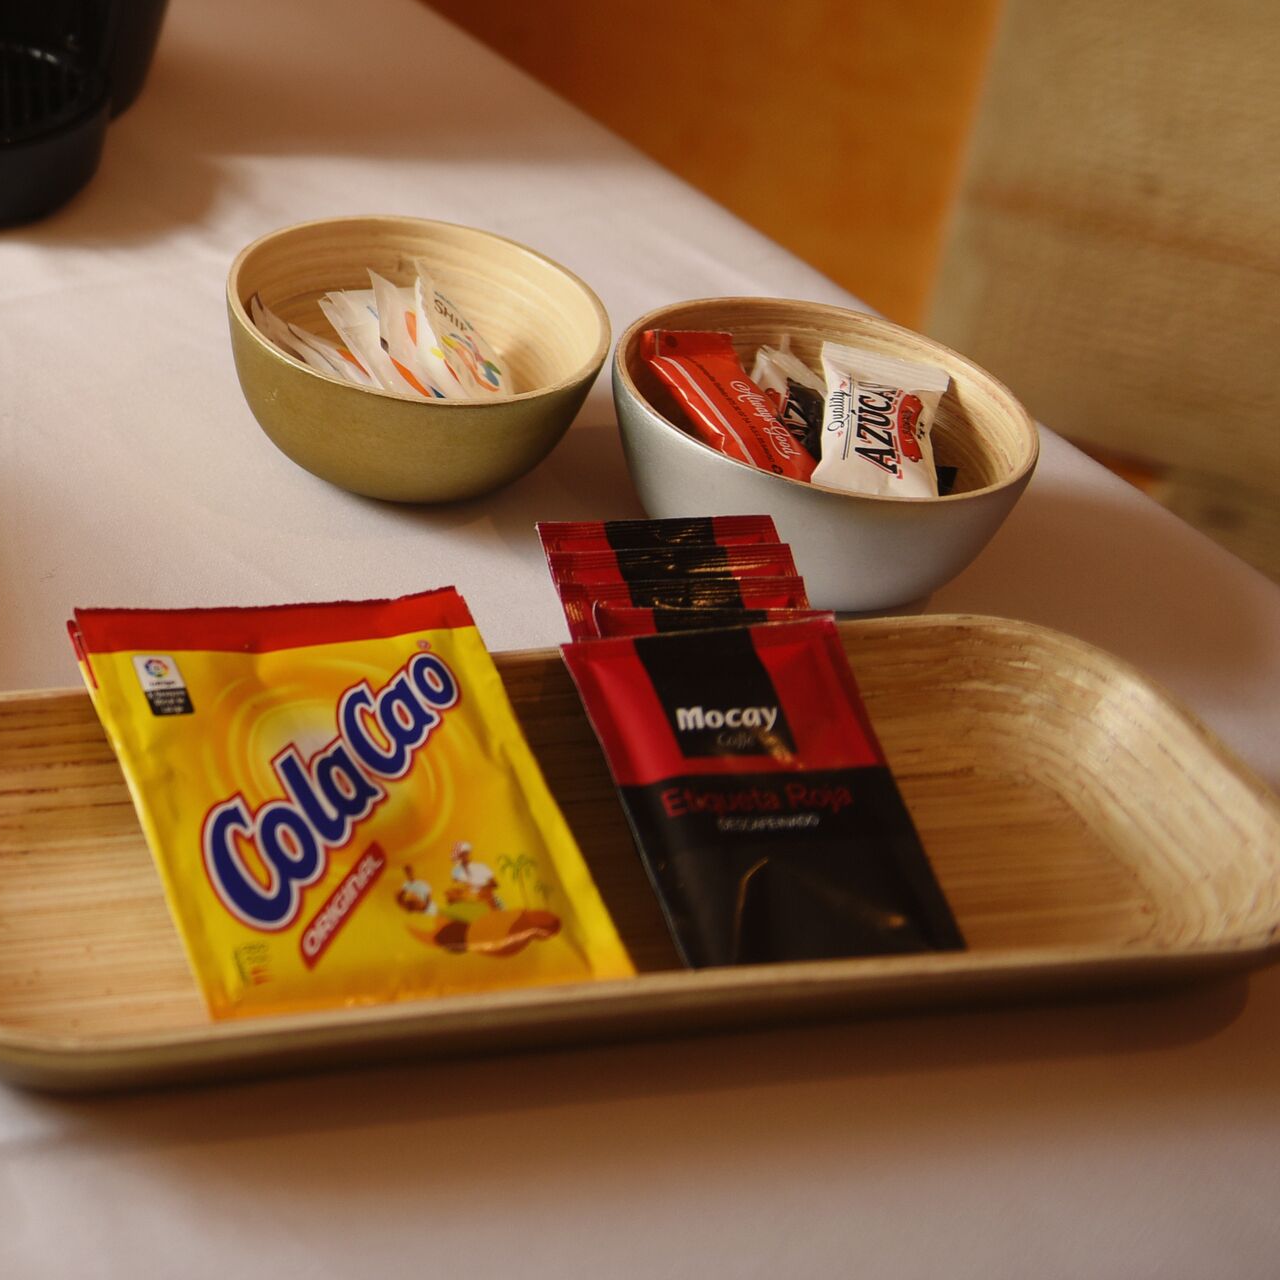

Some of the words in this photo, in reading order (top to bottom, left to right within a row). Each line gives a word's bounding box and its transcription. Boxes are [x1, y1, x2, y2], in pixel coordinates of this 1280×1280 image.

[730, 380, 774, 423] Always
[762, 419, 801, 460] Good
[827, 390, 851, 431] Quality
[675, 705, 778, 732] Mocay
[202, 650, 461, 934] ColaCao
[301, 854, 384, 957] ORIGINAL
